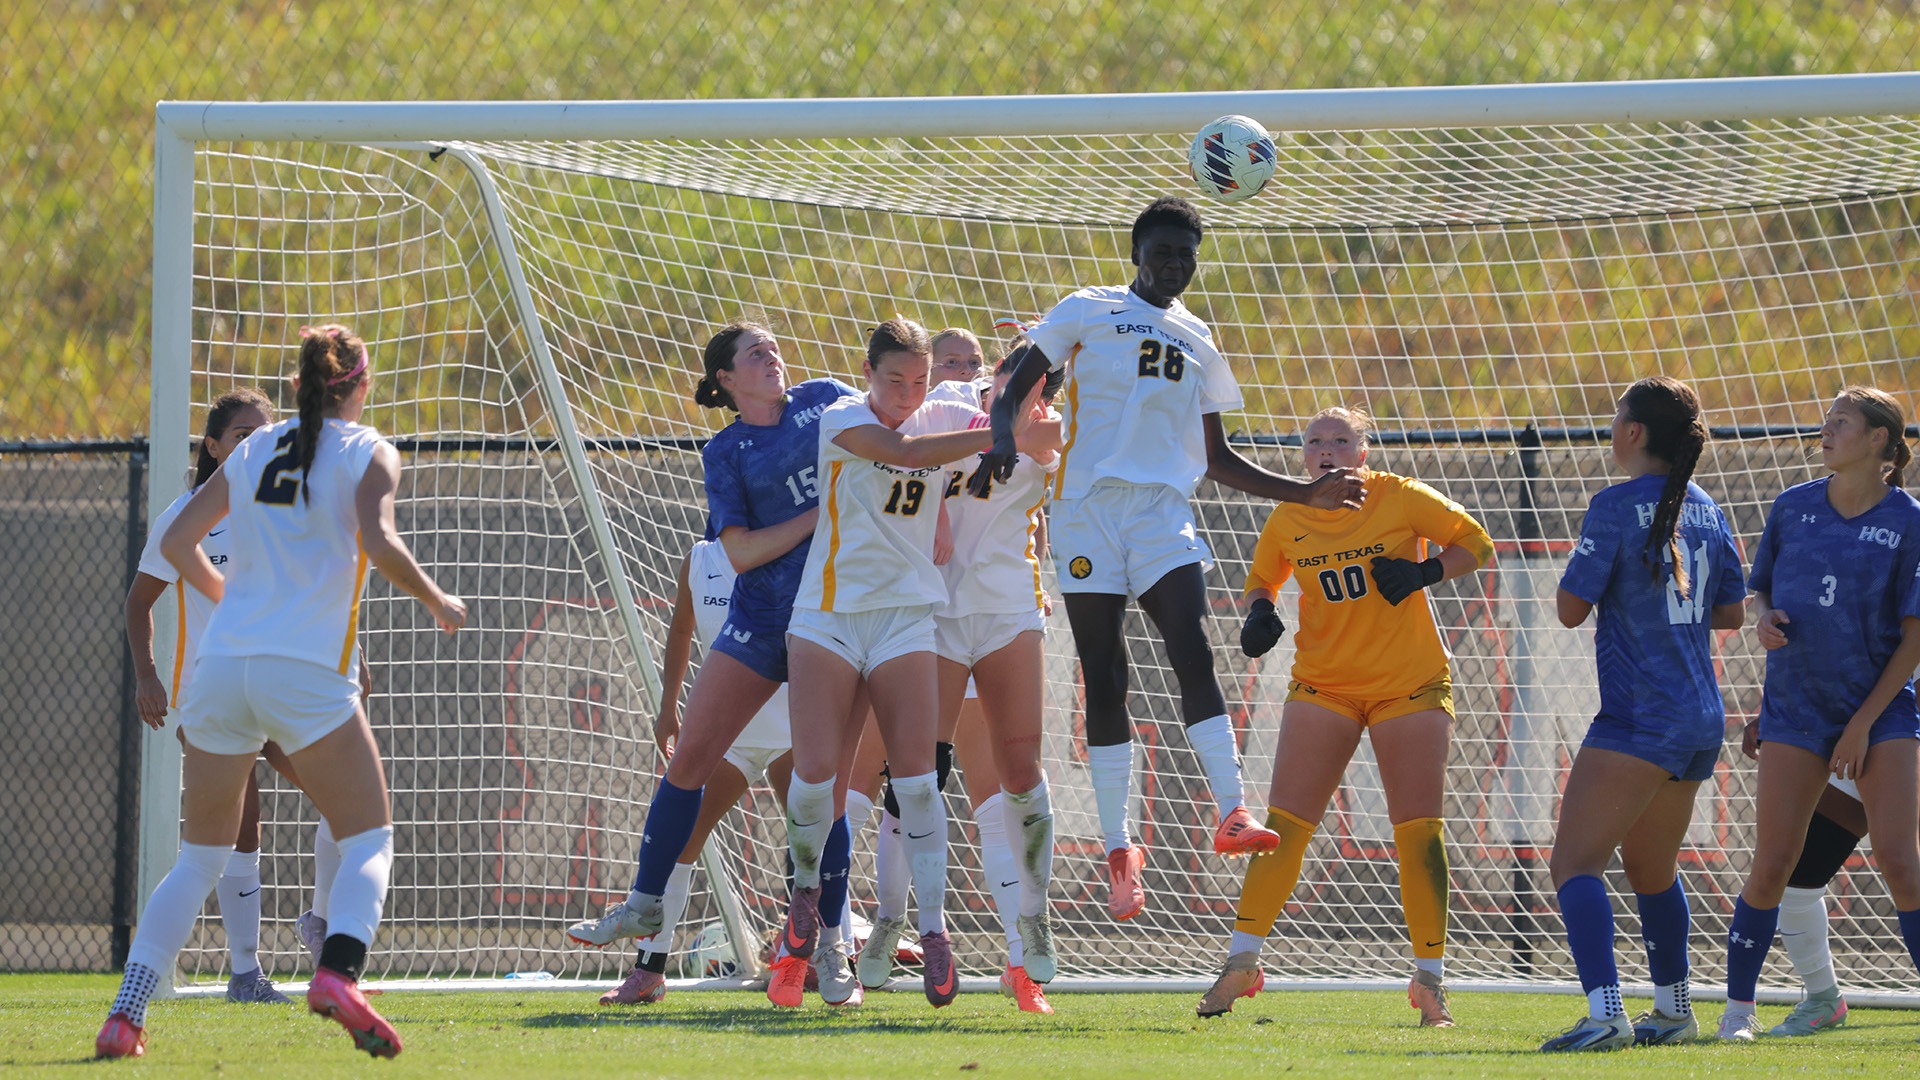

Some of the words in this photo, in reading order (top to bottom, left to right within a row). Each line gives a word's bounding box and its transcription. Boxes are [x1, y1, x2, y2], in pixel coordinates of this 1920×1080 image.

[1115, 324, 1154, 334] EAST
[1138, 338, 1185, 382] 28
[254, 427, 302, 507] 2
[785, 465, 819, 507] 15
[882, 479, 927, 517] 19
[1634, 501, 1720, 531] HKIES
[1858, 526, 1901, 550] HCU
[209, 554, 228, 565] EA
[1297, 554, 1328, 568] EAST
[1334, 543, 1384, 562] TEXAS
[1318, 563, 1369, 603] 00
[1662, 538, 1710, 625] 21
[1819, 575, 1838, 607] 3
[703, 596, 731, 607] EAS
